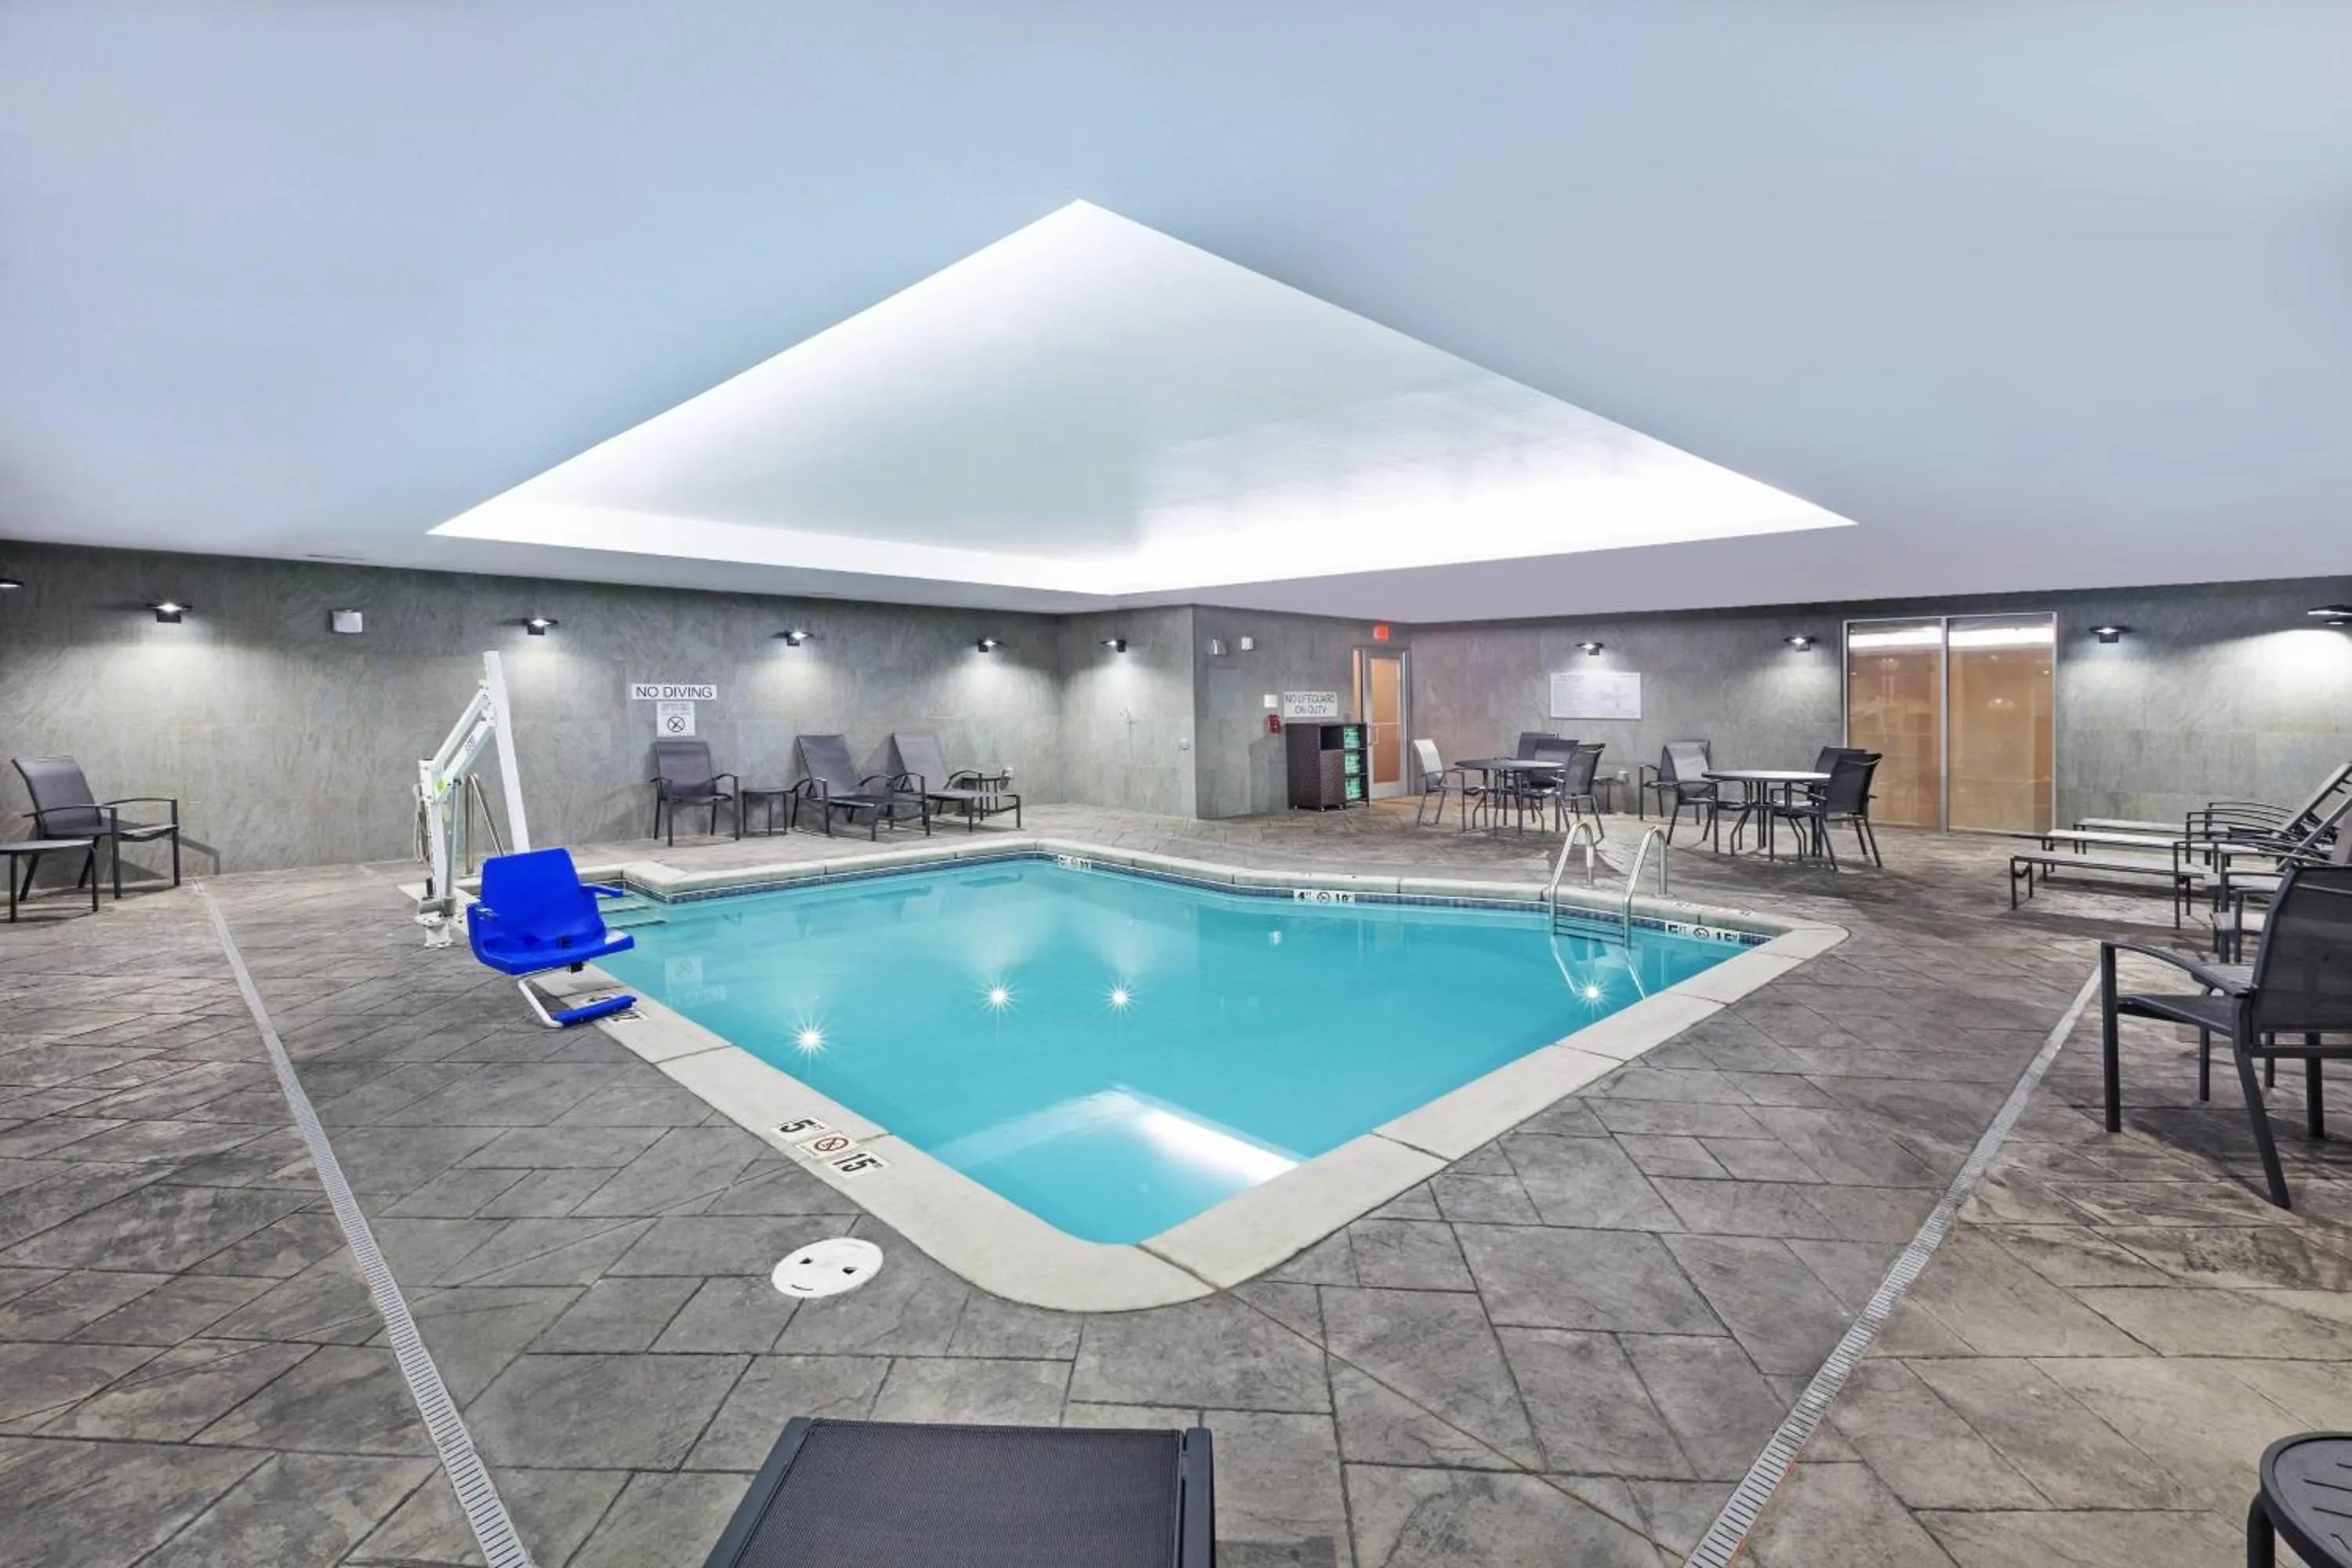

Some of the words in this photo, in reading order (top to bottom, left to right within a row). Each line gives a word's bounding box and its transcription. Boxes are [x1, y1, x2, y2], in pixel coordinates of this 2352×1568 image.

[636, 686, 659, 698] NO
[662, 686, 713, 699] DIVING
[1285, 694, 1298, 704] NO
[1298, 694, 1335, 703] LIFEGUARD
[1294, 705, 1306, 714] ON
[1307, 705, 1327, 714] DUTY
[779, 1119, 816, 1133] 5
[832, 1153, 877, 1172] 15
